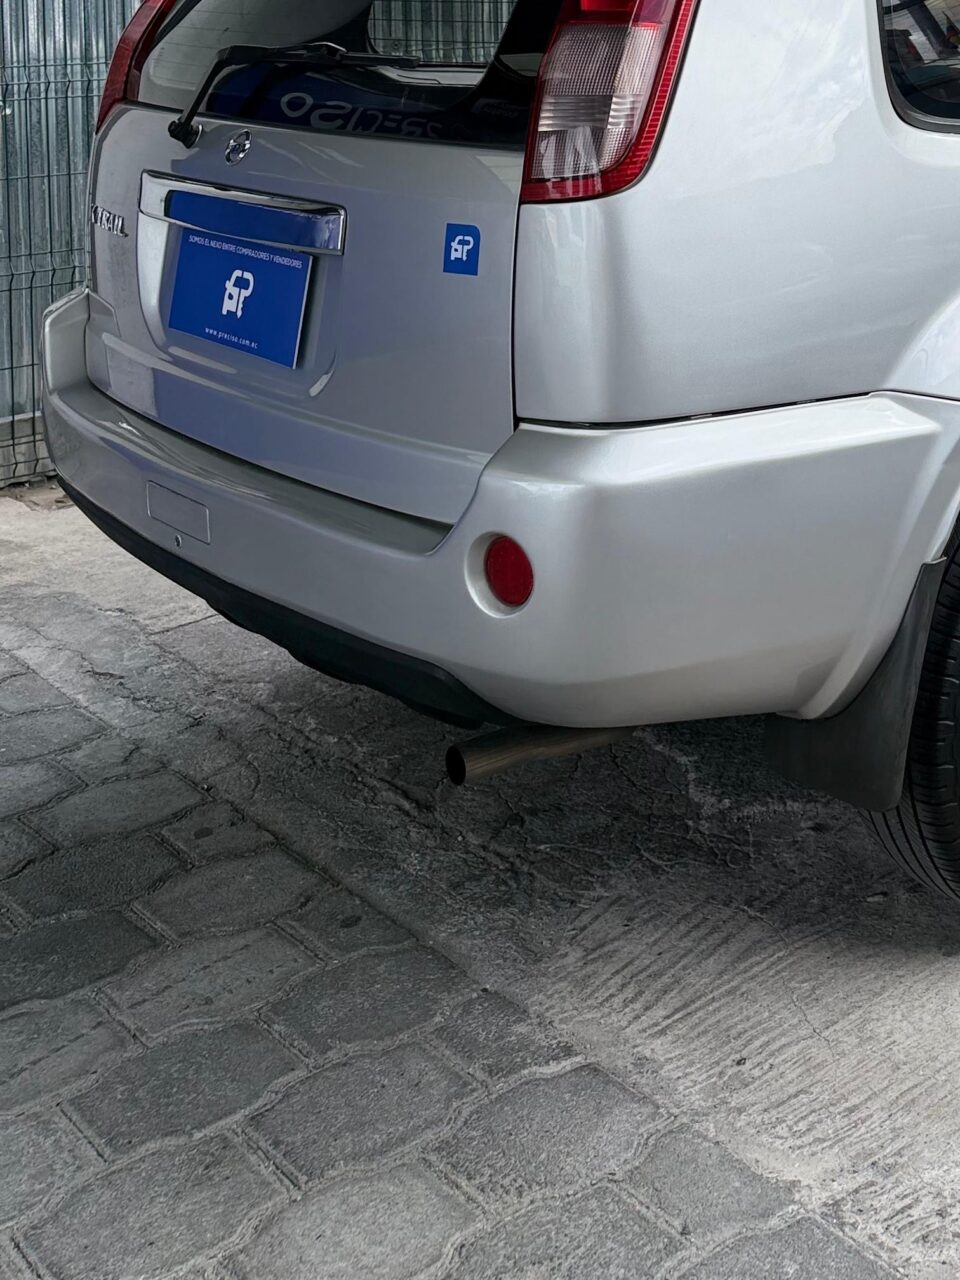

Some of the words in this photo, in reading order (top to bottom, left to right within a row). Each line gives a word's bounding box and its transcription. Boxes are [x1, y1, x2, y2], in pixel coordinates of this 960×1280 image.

[188, 235, 204, 245] SOMOS
[205, 238, 210, 246] EL
[210, 240, 222, 249] NEXO
[222, 242, 236, 253] ENTRE
[236, 246, 270, 261] COMPRADORES
[273, 255, 302, 268] VENDEDORES
[205, 327, 258, 349] www.preciso.com.ec
